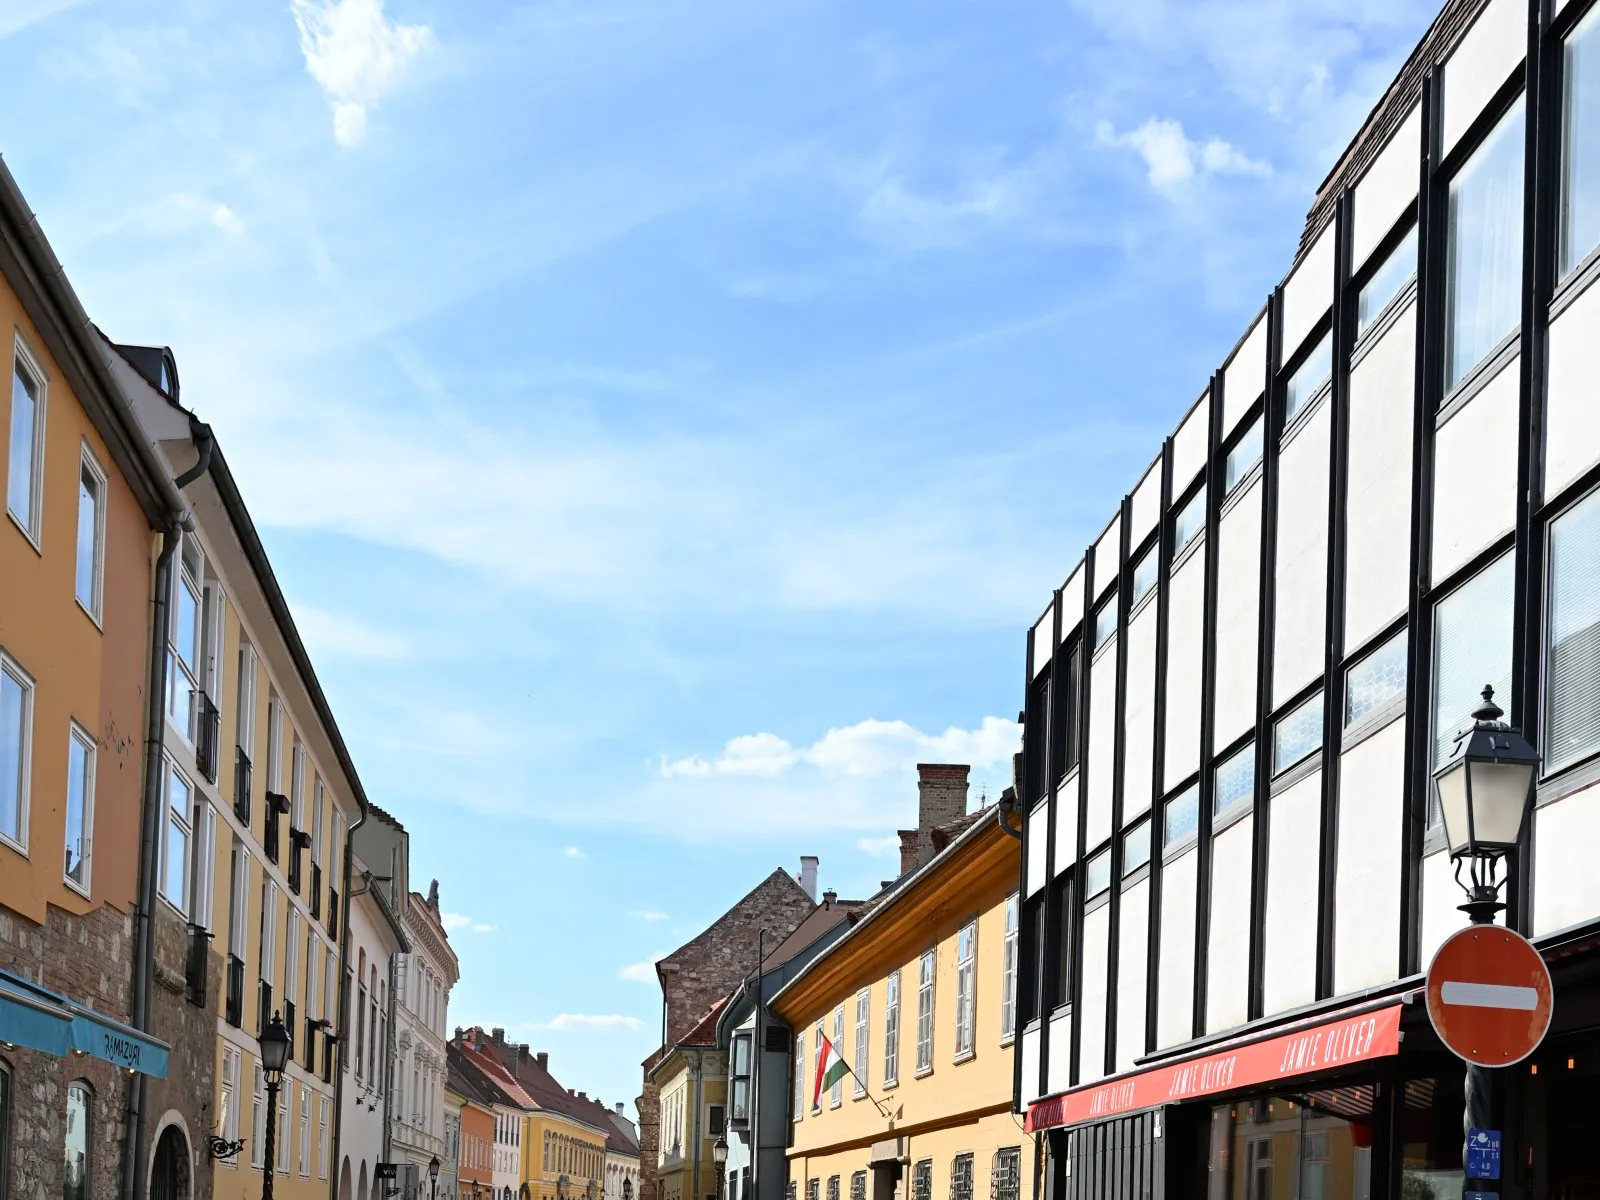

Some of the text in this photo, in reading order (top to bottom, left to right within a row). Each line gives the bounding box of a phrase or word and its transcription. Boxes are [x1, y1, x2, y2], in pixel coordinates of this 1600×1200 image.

[104, 1033, 140, 1066] RAMAZURI
[1280, 1018, 1376, 1072] JAMIE OLIVER
[1169, 1056, 1236, 1096] JAMIE OLIVER
[1090, 1082, 1135, 1115] JAMIE OLIVER
